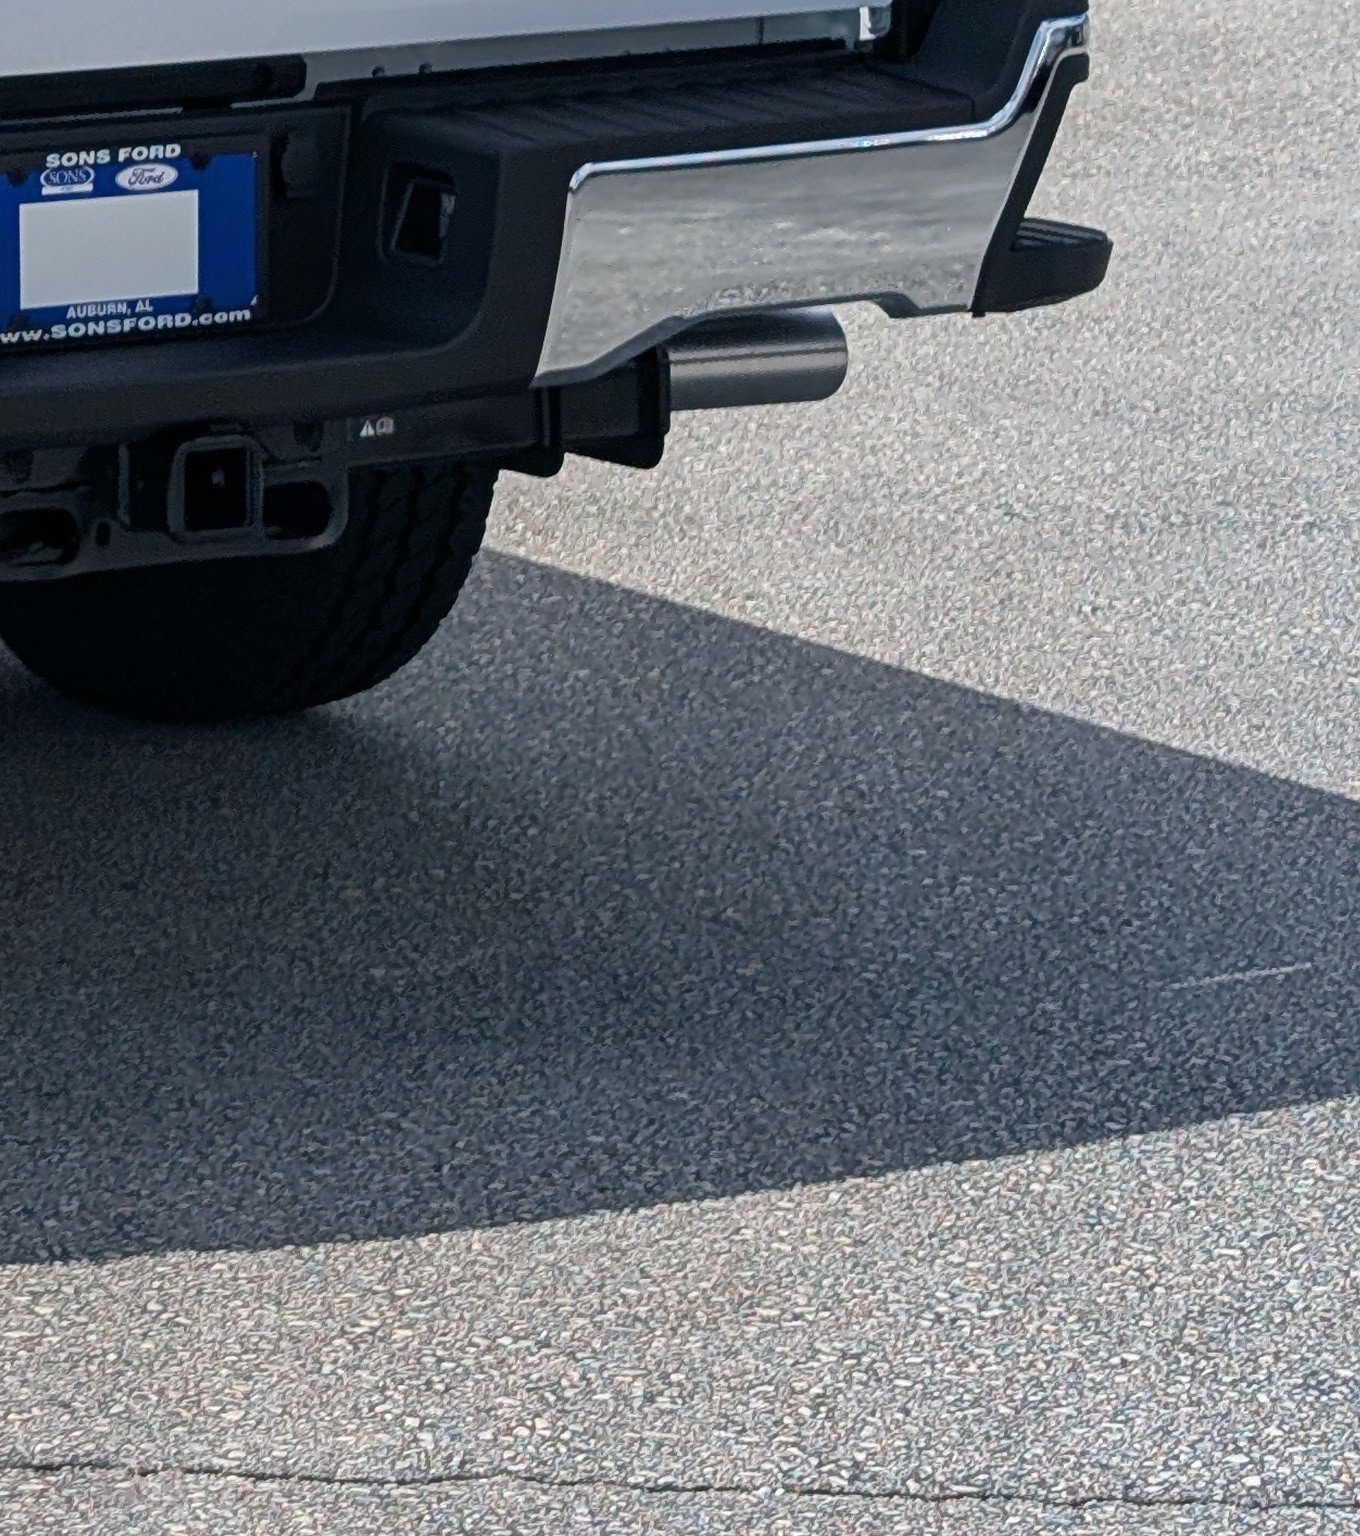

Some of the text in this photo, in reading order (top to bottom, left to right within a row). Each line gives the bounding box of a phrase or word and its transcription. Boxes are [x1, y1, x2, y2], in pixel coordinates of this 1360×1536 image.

[45, 143, 181, 168] SONS FORD
[48, 168, 88, 184] SONS
[127, 167, 166, 186] Ford
[66, 299, 154, 319] AUBURN, AL
